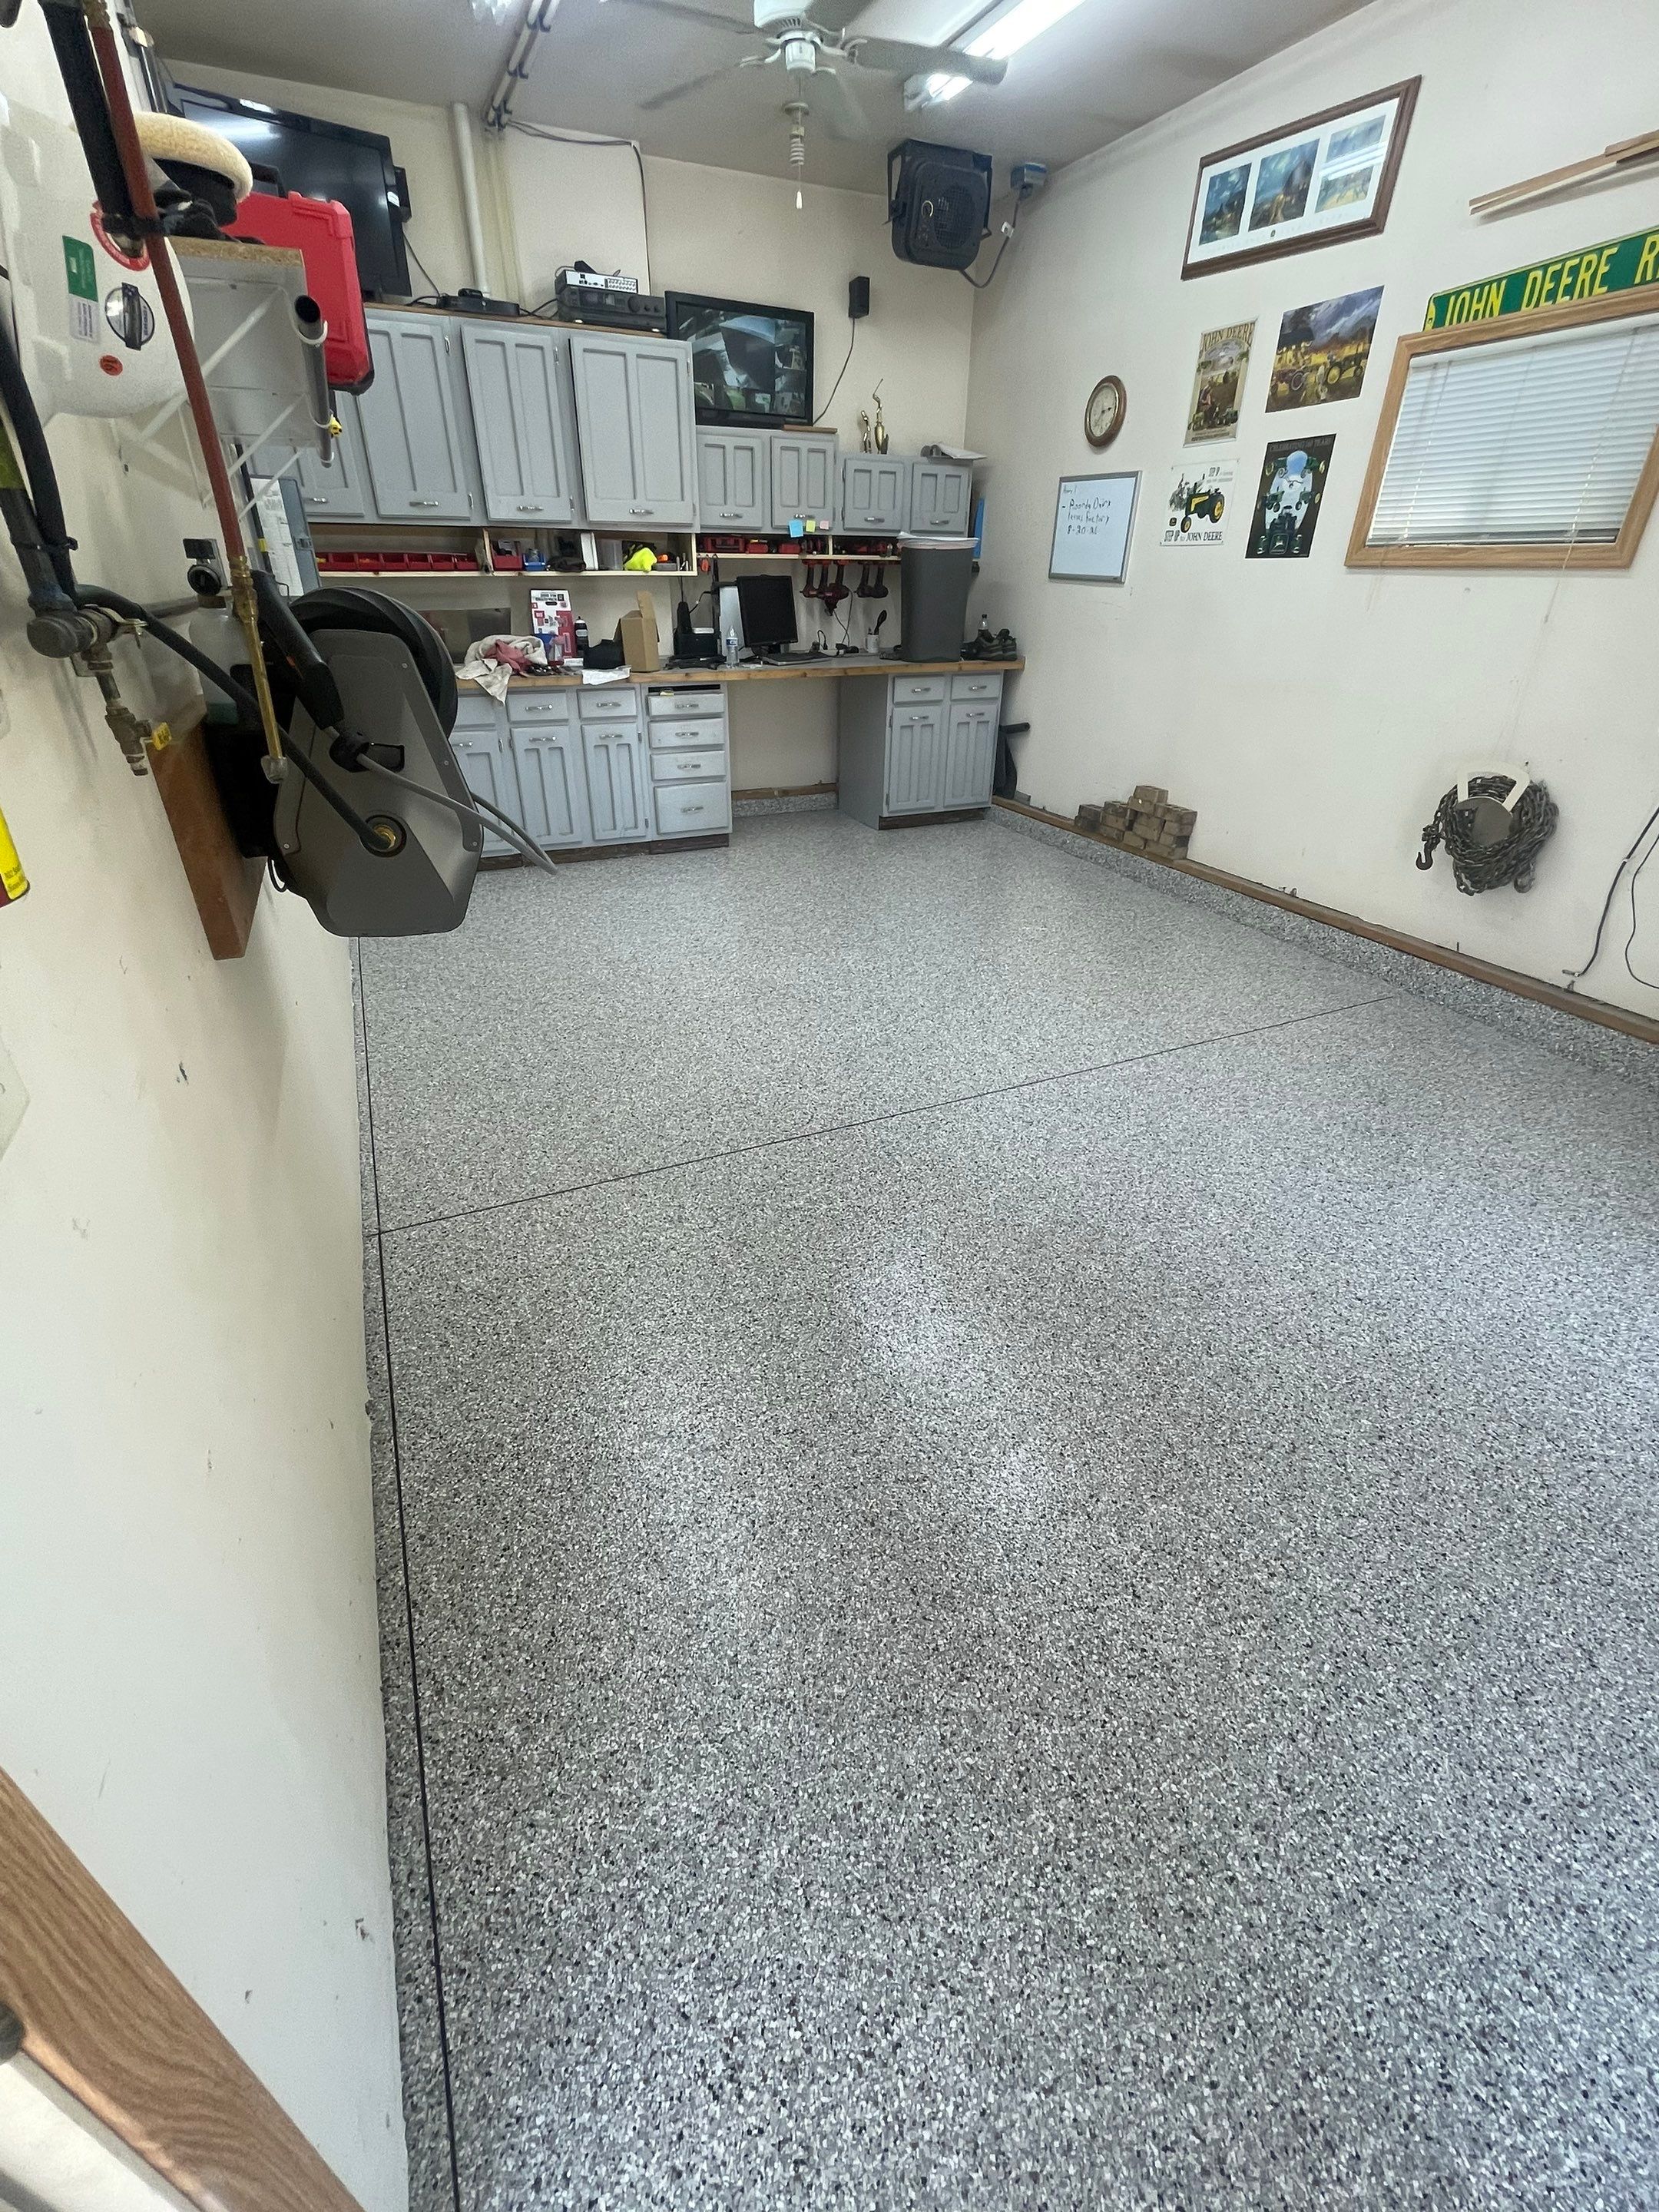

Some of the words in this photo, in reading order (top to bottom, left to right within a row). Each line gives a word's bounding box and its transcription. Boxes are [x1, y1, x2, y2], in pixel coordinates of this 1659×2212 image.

[1444, 279, 1508, 326] JOHN
[1521, 247, 1618, 311] DEERE
[1634, 233, 1659, 285] R
[1202, 330, 1223, 352] JOHN
[1227, 322, 1255, 347] DEERE
[1186, 531, 1202, 541] JOHN
[1204, 531, 1223, 541] DEERE
